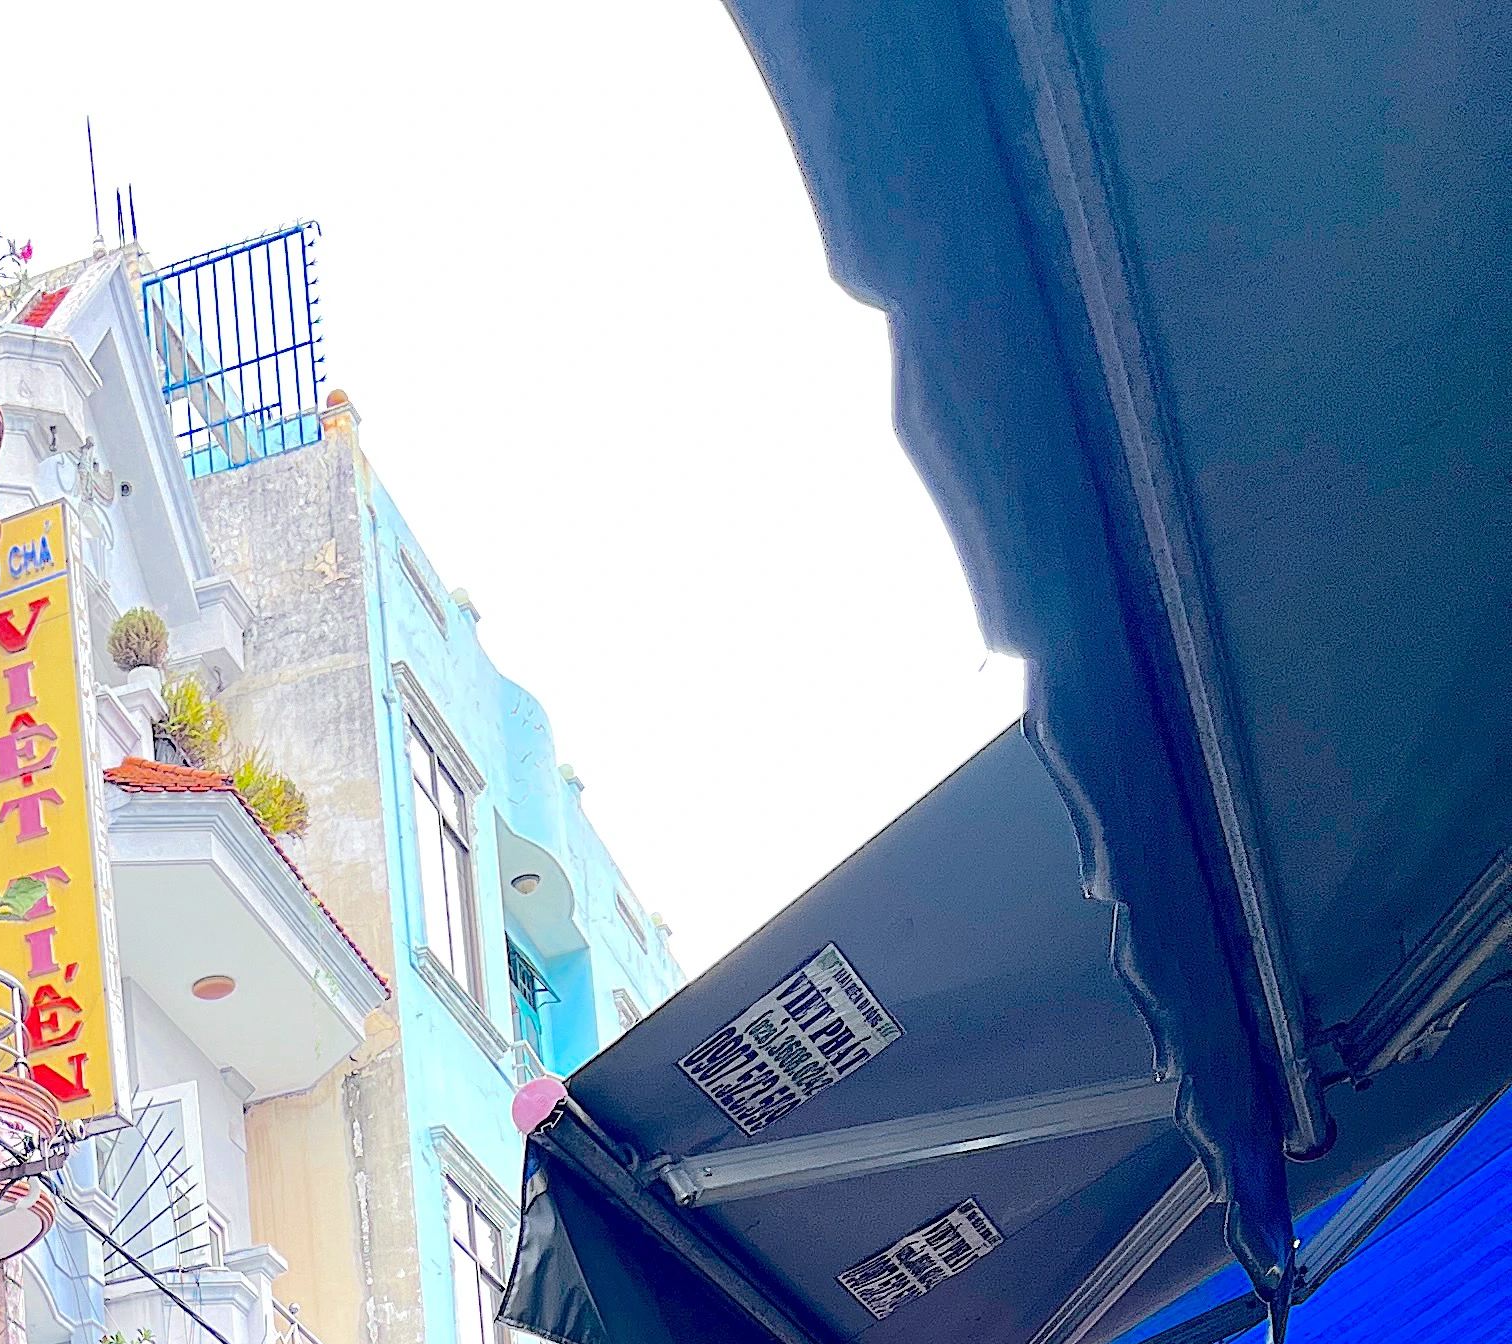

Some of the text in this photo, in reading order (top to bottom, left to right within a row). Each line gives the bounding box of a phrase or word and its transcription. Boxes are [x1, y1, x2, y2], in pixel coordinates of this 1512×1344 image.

[9, 519, 53, 577] CHẢ
[6, 864, 90, 1104] TIẾN
[775, 970, 874, 1075] VIỆT PHÁT
